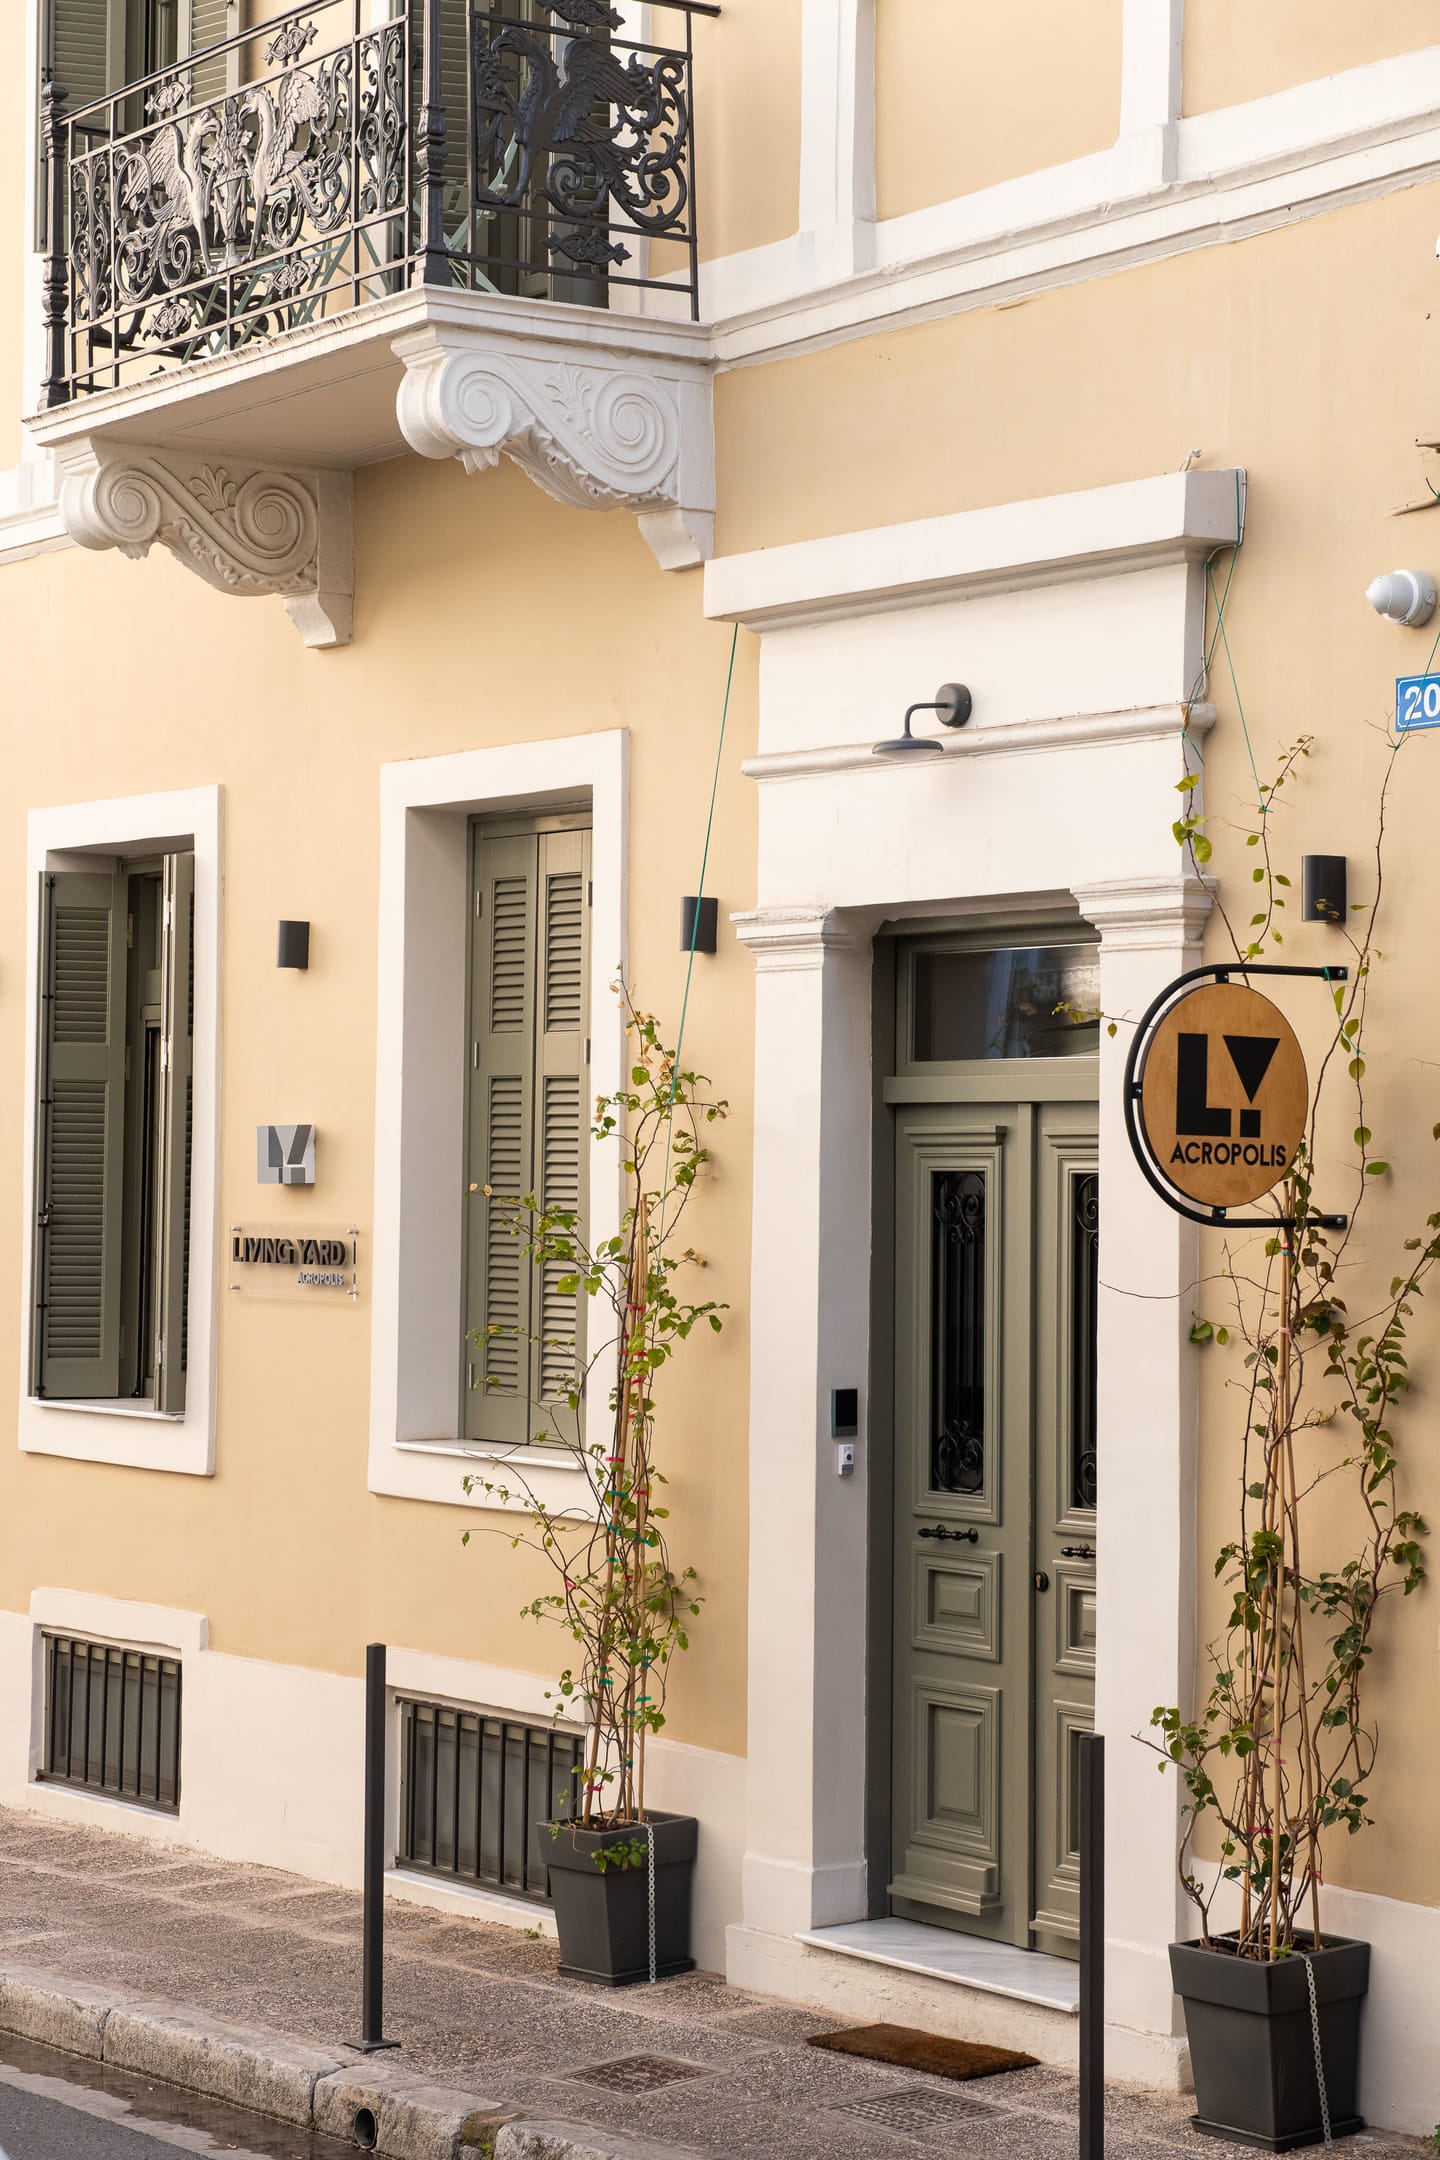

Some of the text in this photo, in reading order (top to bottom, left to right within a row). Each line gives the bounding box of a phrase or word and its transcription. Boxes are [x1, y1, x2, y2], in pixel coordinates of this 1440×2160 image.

[1404, 683, 1440, 721] 20
[1170, 1142, 1287, 1167] ACROPOLIS
[233, 1237, 346, 1266] LIVING YARD
[298, 1272, 344, 1286] ACROPOLIS
